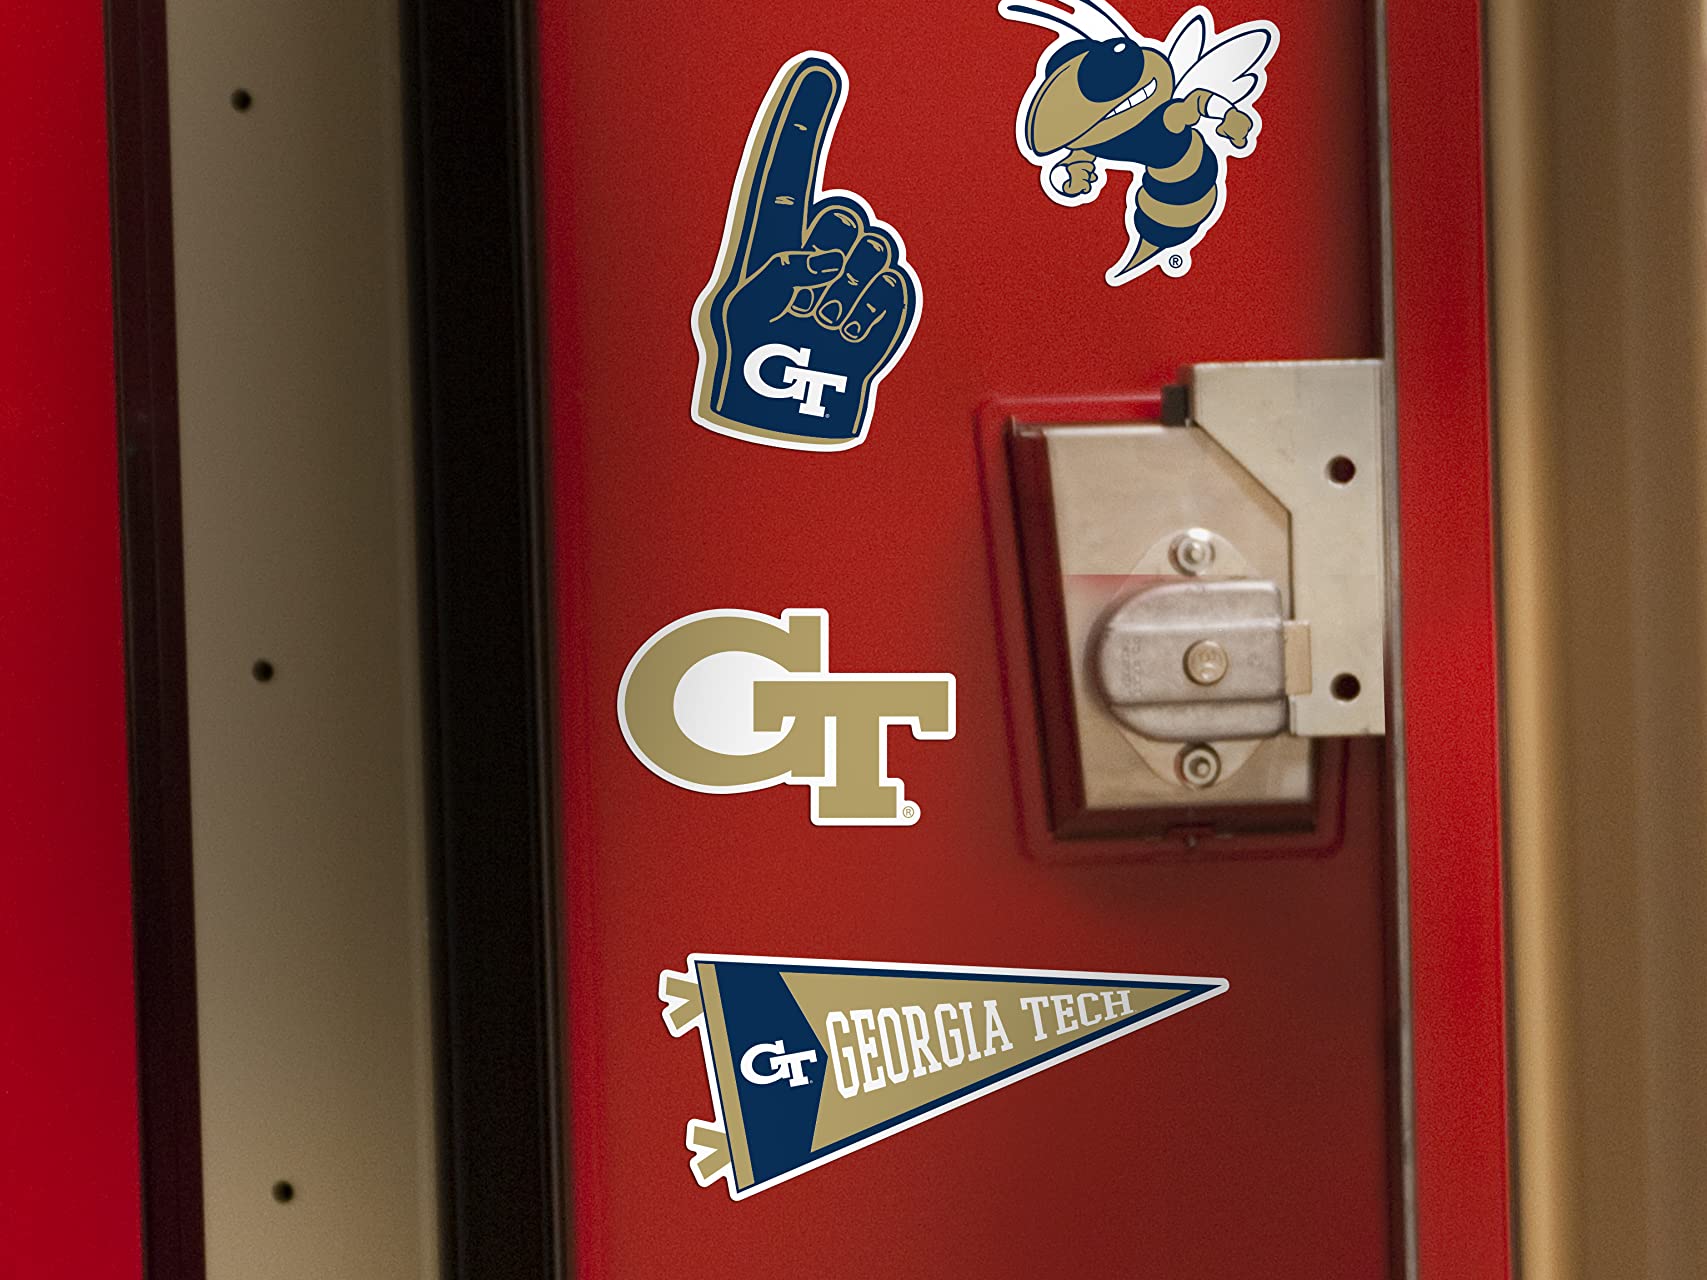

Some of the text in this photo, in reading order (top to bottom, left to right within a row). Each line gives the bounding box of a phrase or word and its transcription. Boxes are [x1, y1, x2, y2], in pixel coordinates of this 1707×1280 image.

[743, 343, 848, 417] GT
[624, 615, 949, 819] GT
[739, 1039, 818, 1088] GT
[825, 989, 1134, 1099] GEORGIA TECH
